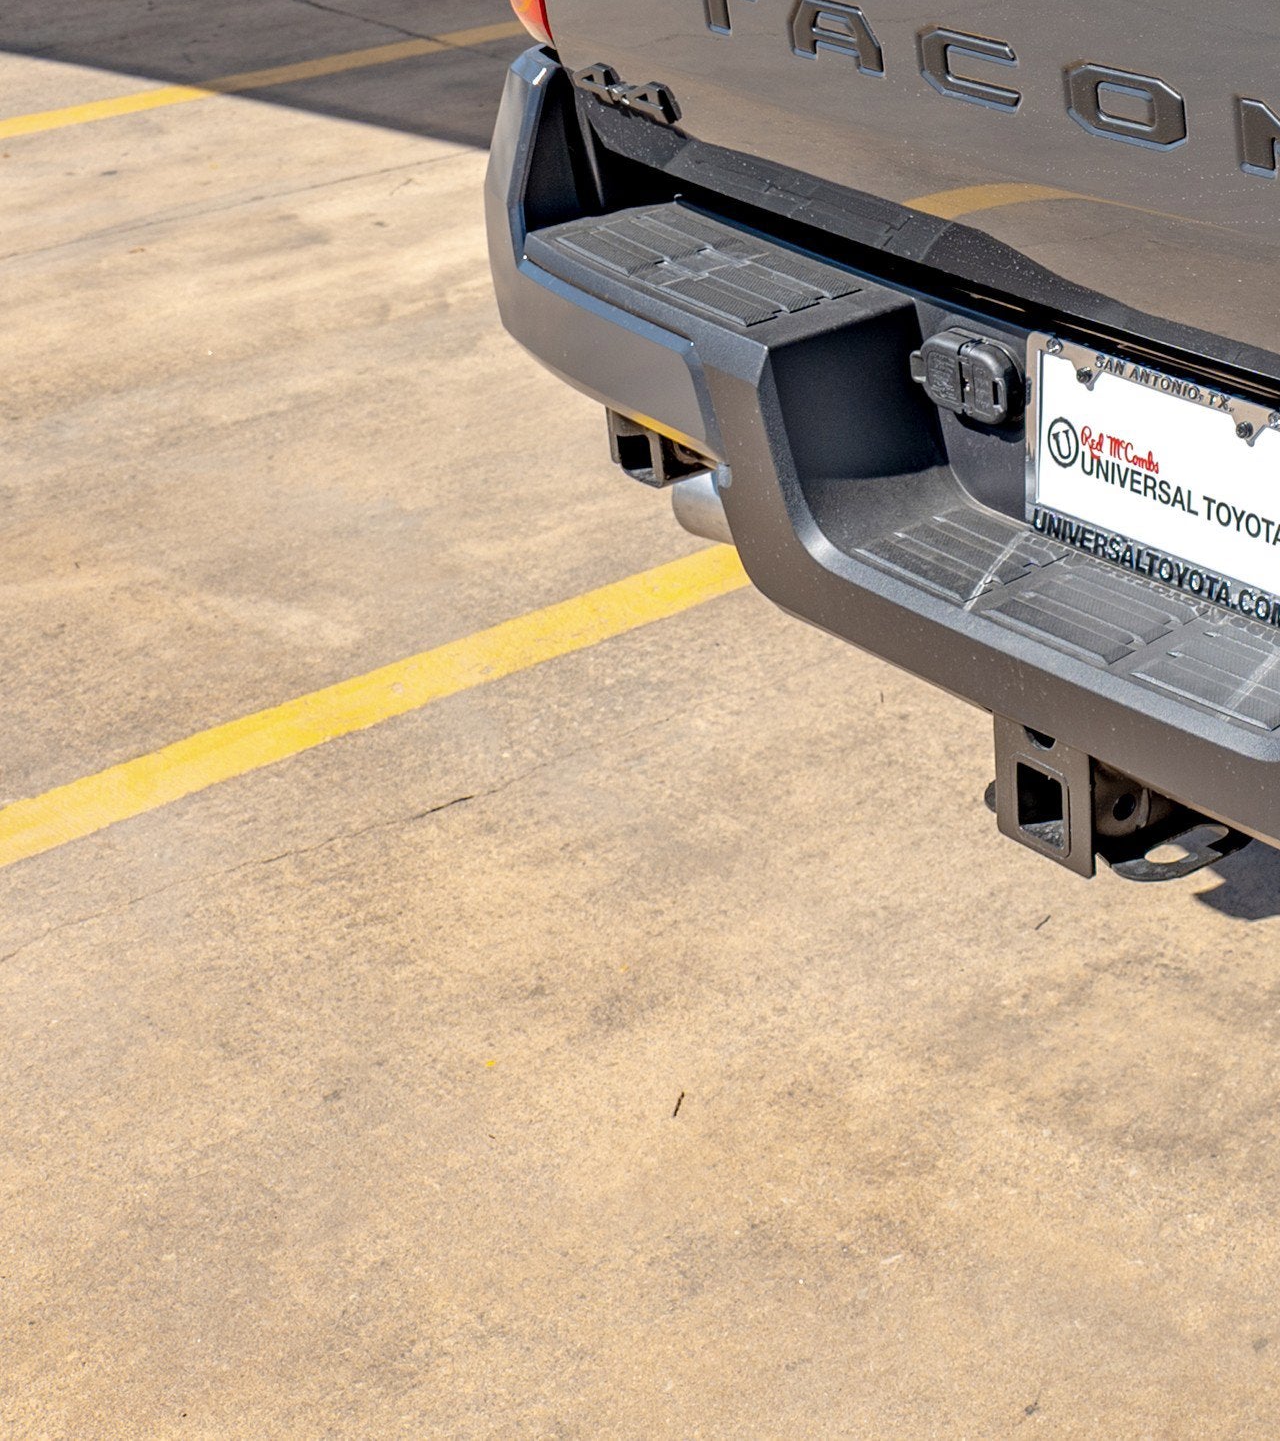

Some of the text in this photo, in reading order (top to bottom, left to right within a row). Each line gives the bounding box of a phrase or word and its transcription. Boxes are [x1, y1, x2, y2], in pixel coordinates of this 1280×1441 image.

[1095, 354, 1127, 376] SAN
[1081, 425, 1159, 474] Red McCombs
[1080, 450, 1199, 517] UNIVERSAL
